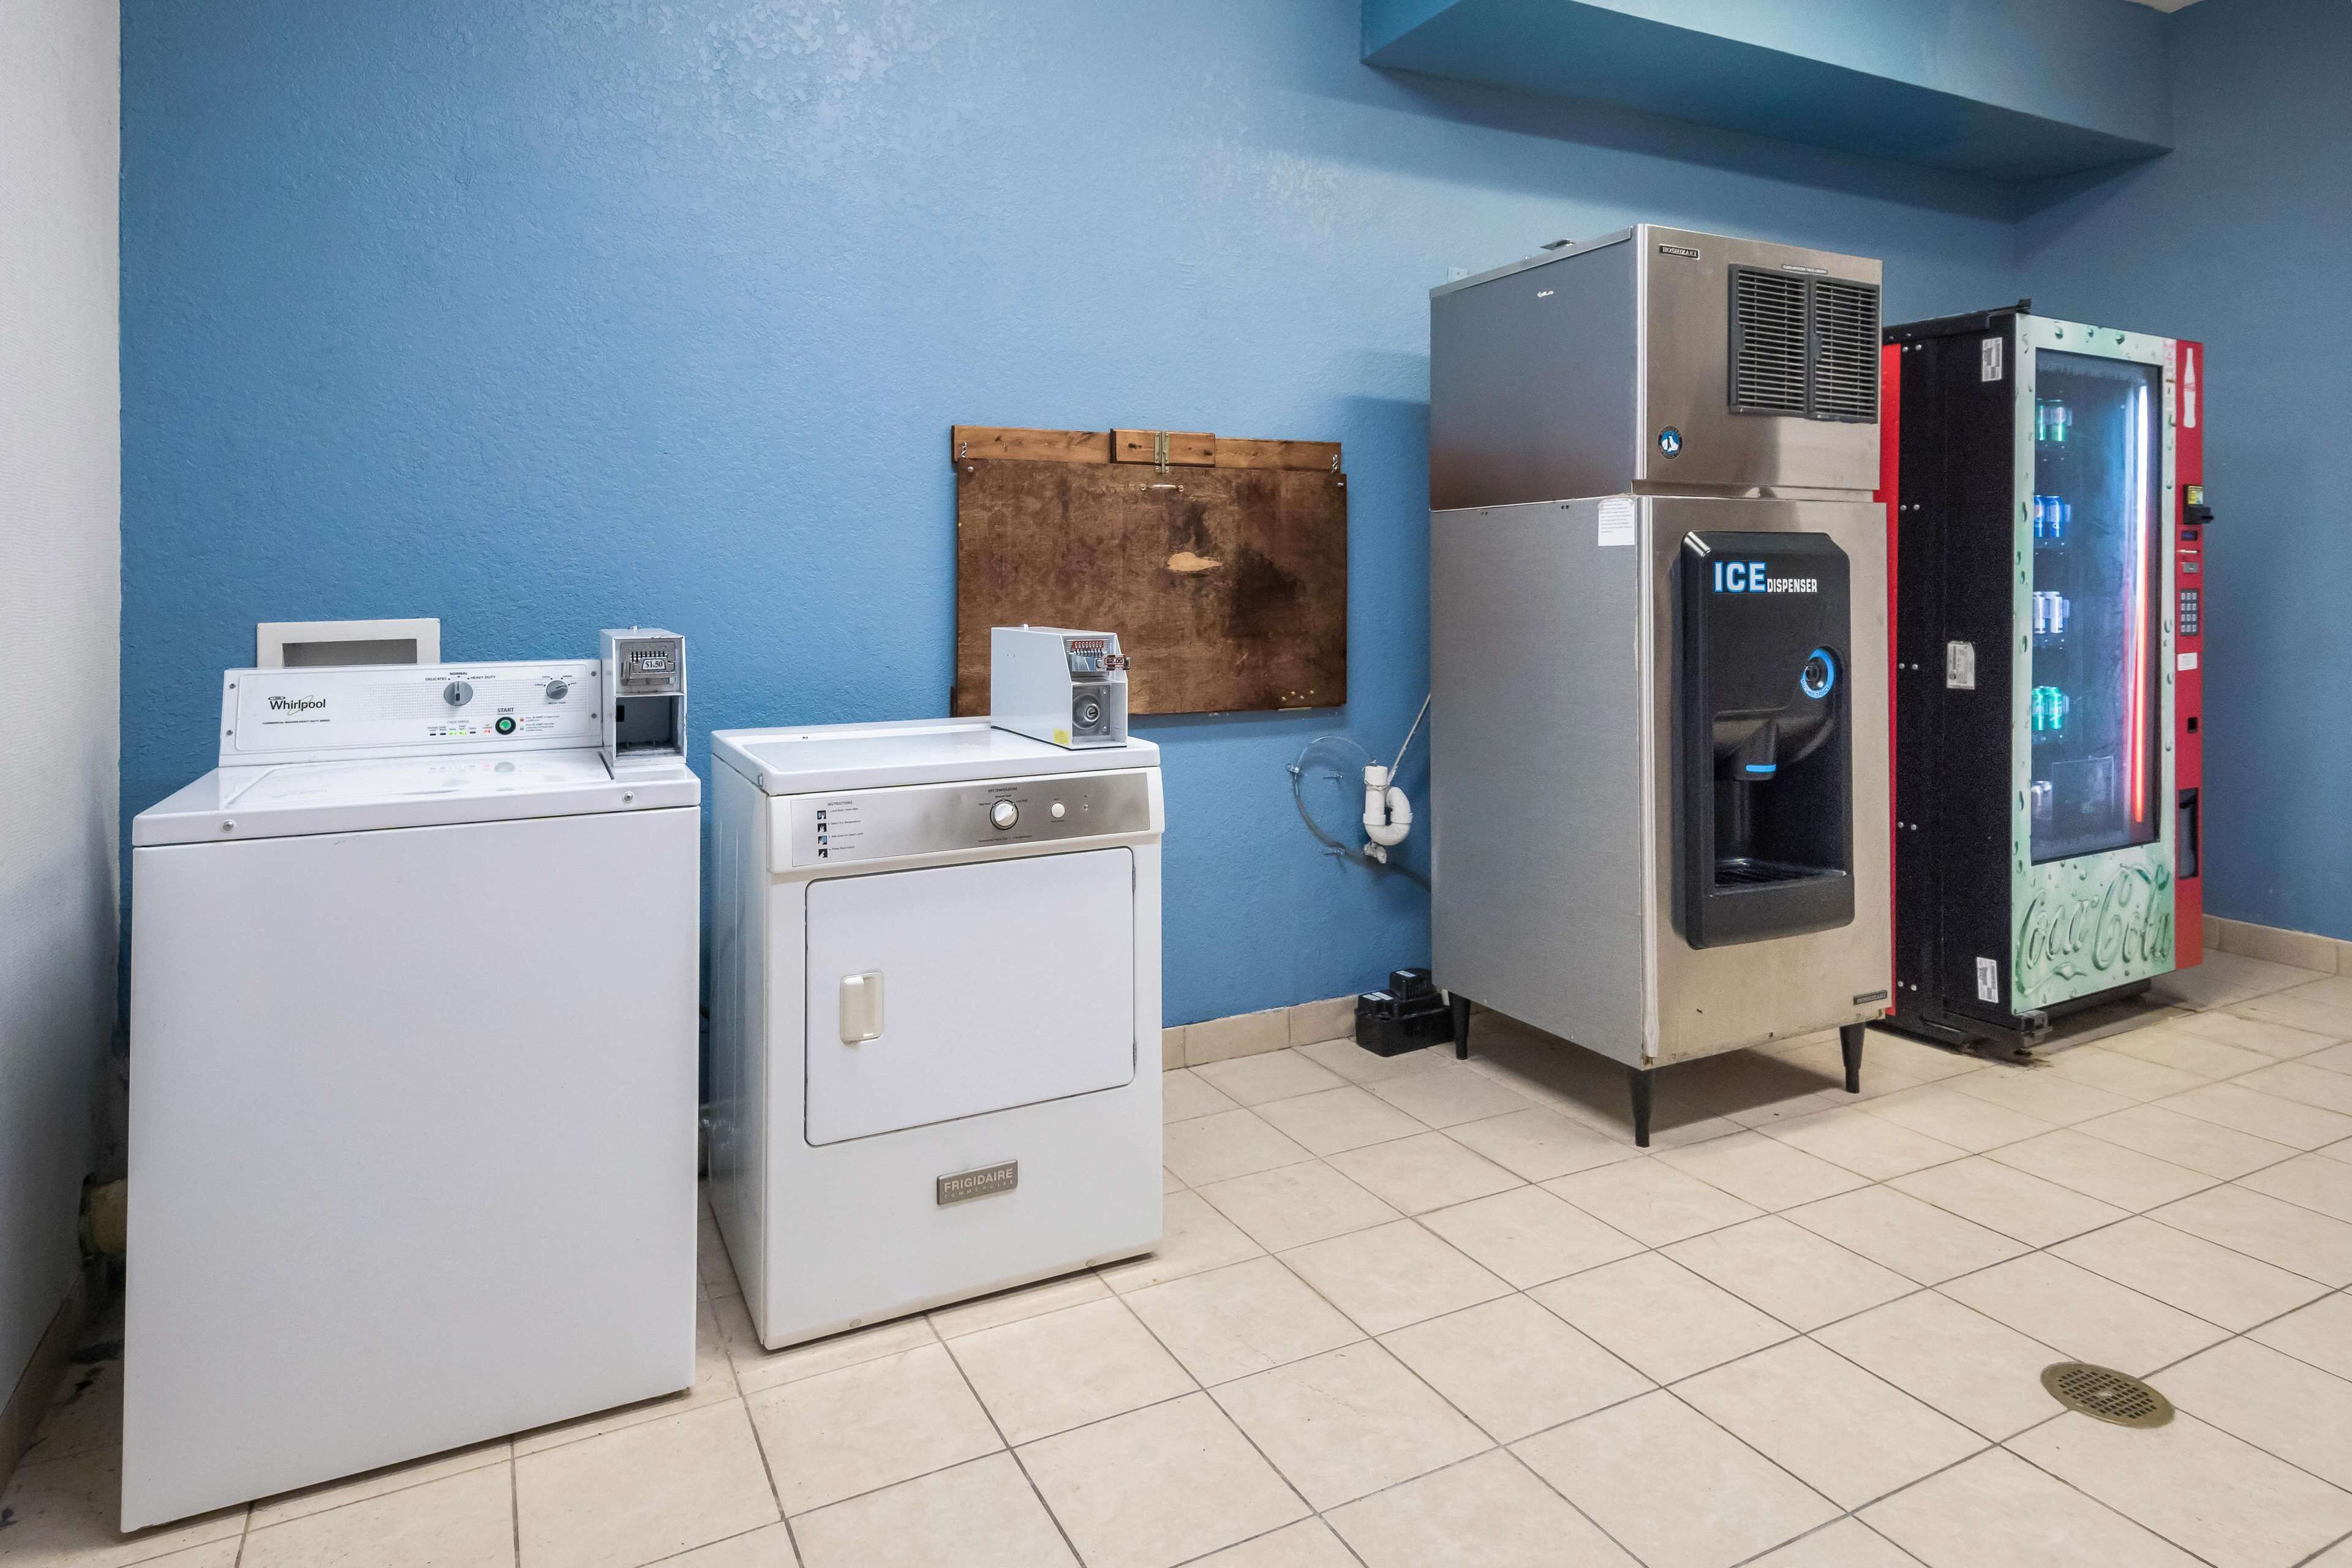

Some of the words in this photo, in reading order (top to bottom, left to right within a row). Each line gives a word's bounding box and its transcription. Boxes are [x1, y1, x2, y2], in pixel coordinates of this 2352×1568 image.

[1714, 562, 1766, 592] ICE
[1766, 578, 1818, 593] DISPENSER
[270, 698, 326, 712] Whirlpool
[944, 1168, 1013, 1193] FRIGIDAIRE
